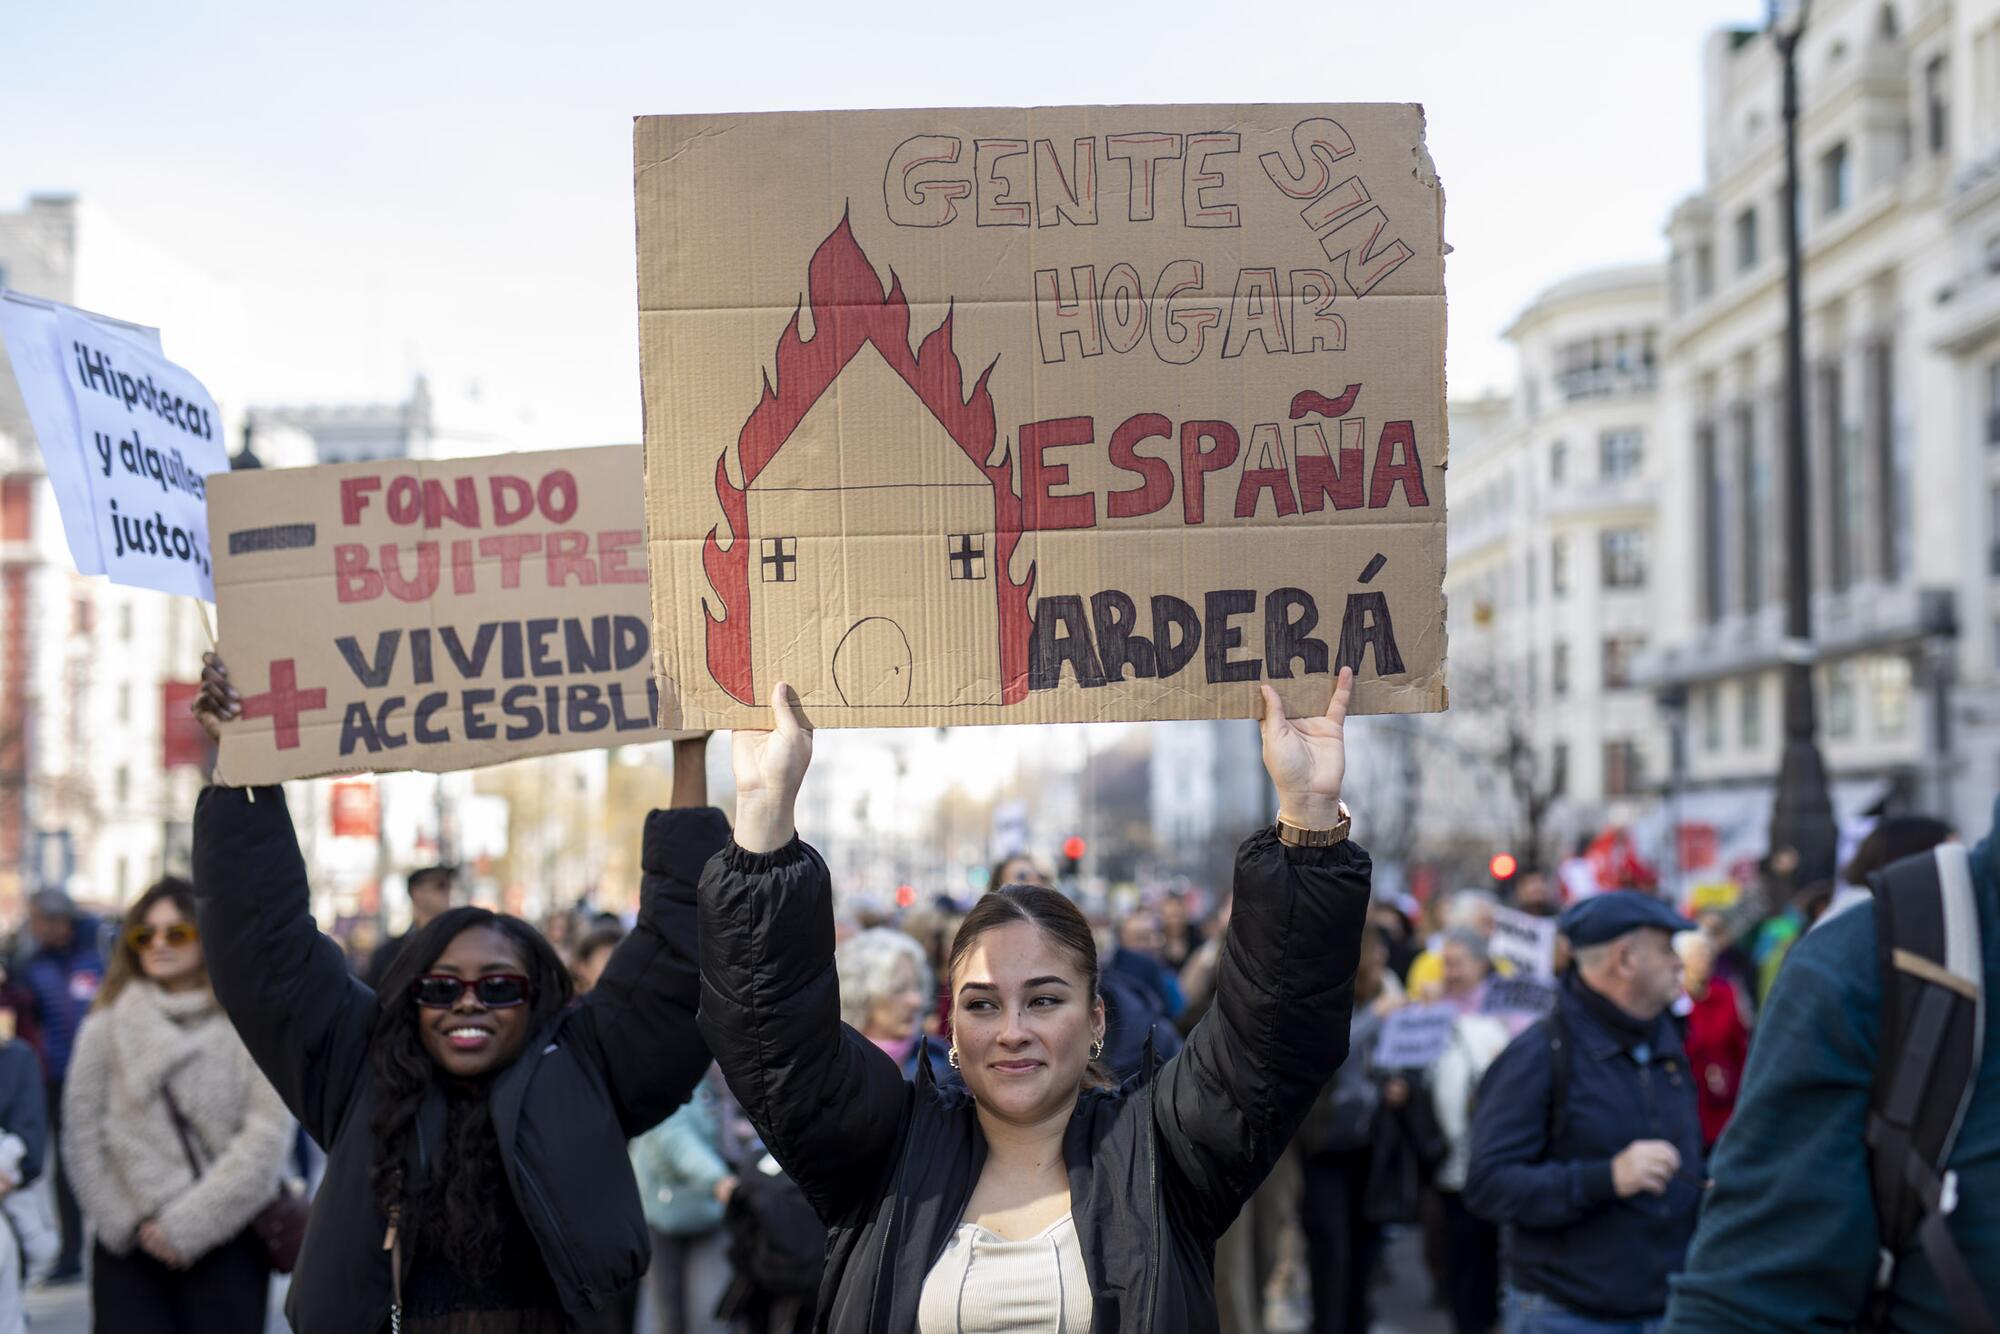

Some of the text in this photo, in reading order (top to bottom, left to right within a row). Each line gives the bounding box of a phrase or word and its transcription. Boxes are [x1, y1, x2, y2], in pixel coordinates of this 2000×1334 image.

[883, 117, 1416, 298] GENTE SIN
[1034, 259, 1347, 365] HOGAR
[94, 430, 206, 501] y alquile
[339, 469, 579, 529] FONDO
[1018, 383, 1430, 531] ESPAÑA
[334, 530, 649, 604] BUITRE
[335, 614, 649, 688] VIVIEND
[1028, 552, 1406, 690] ARDERÁ
